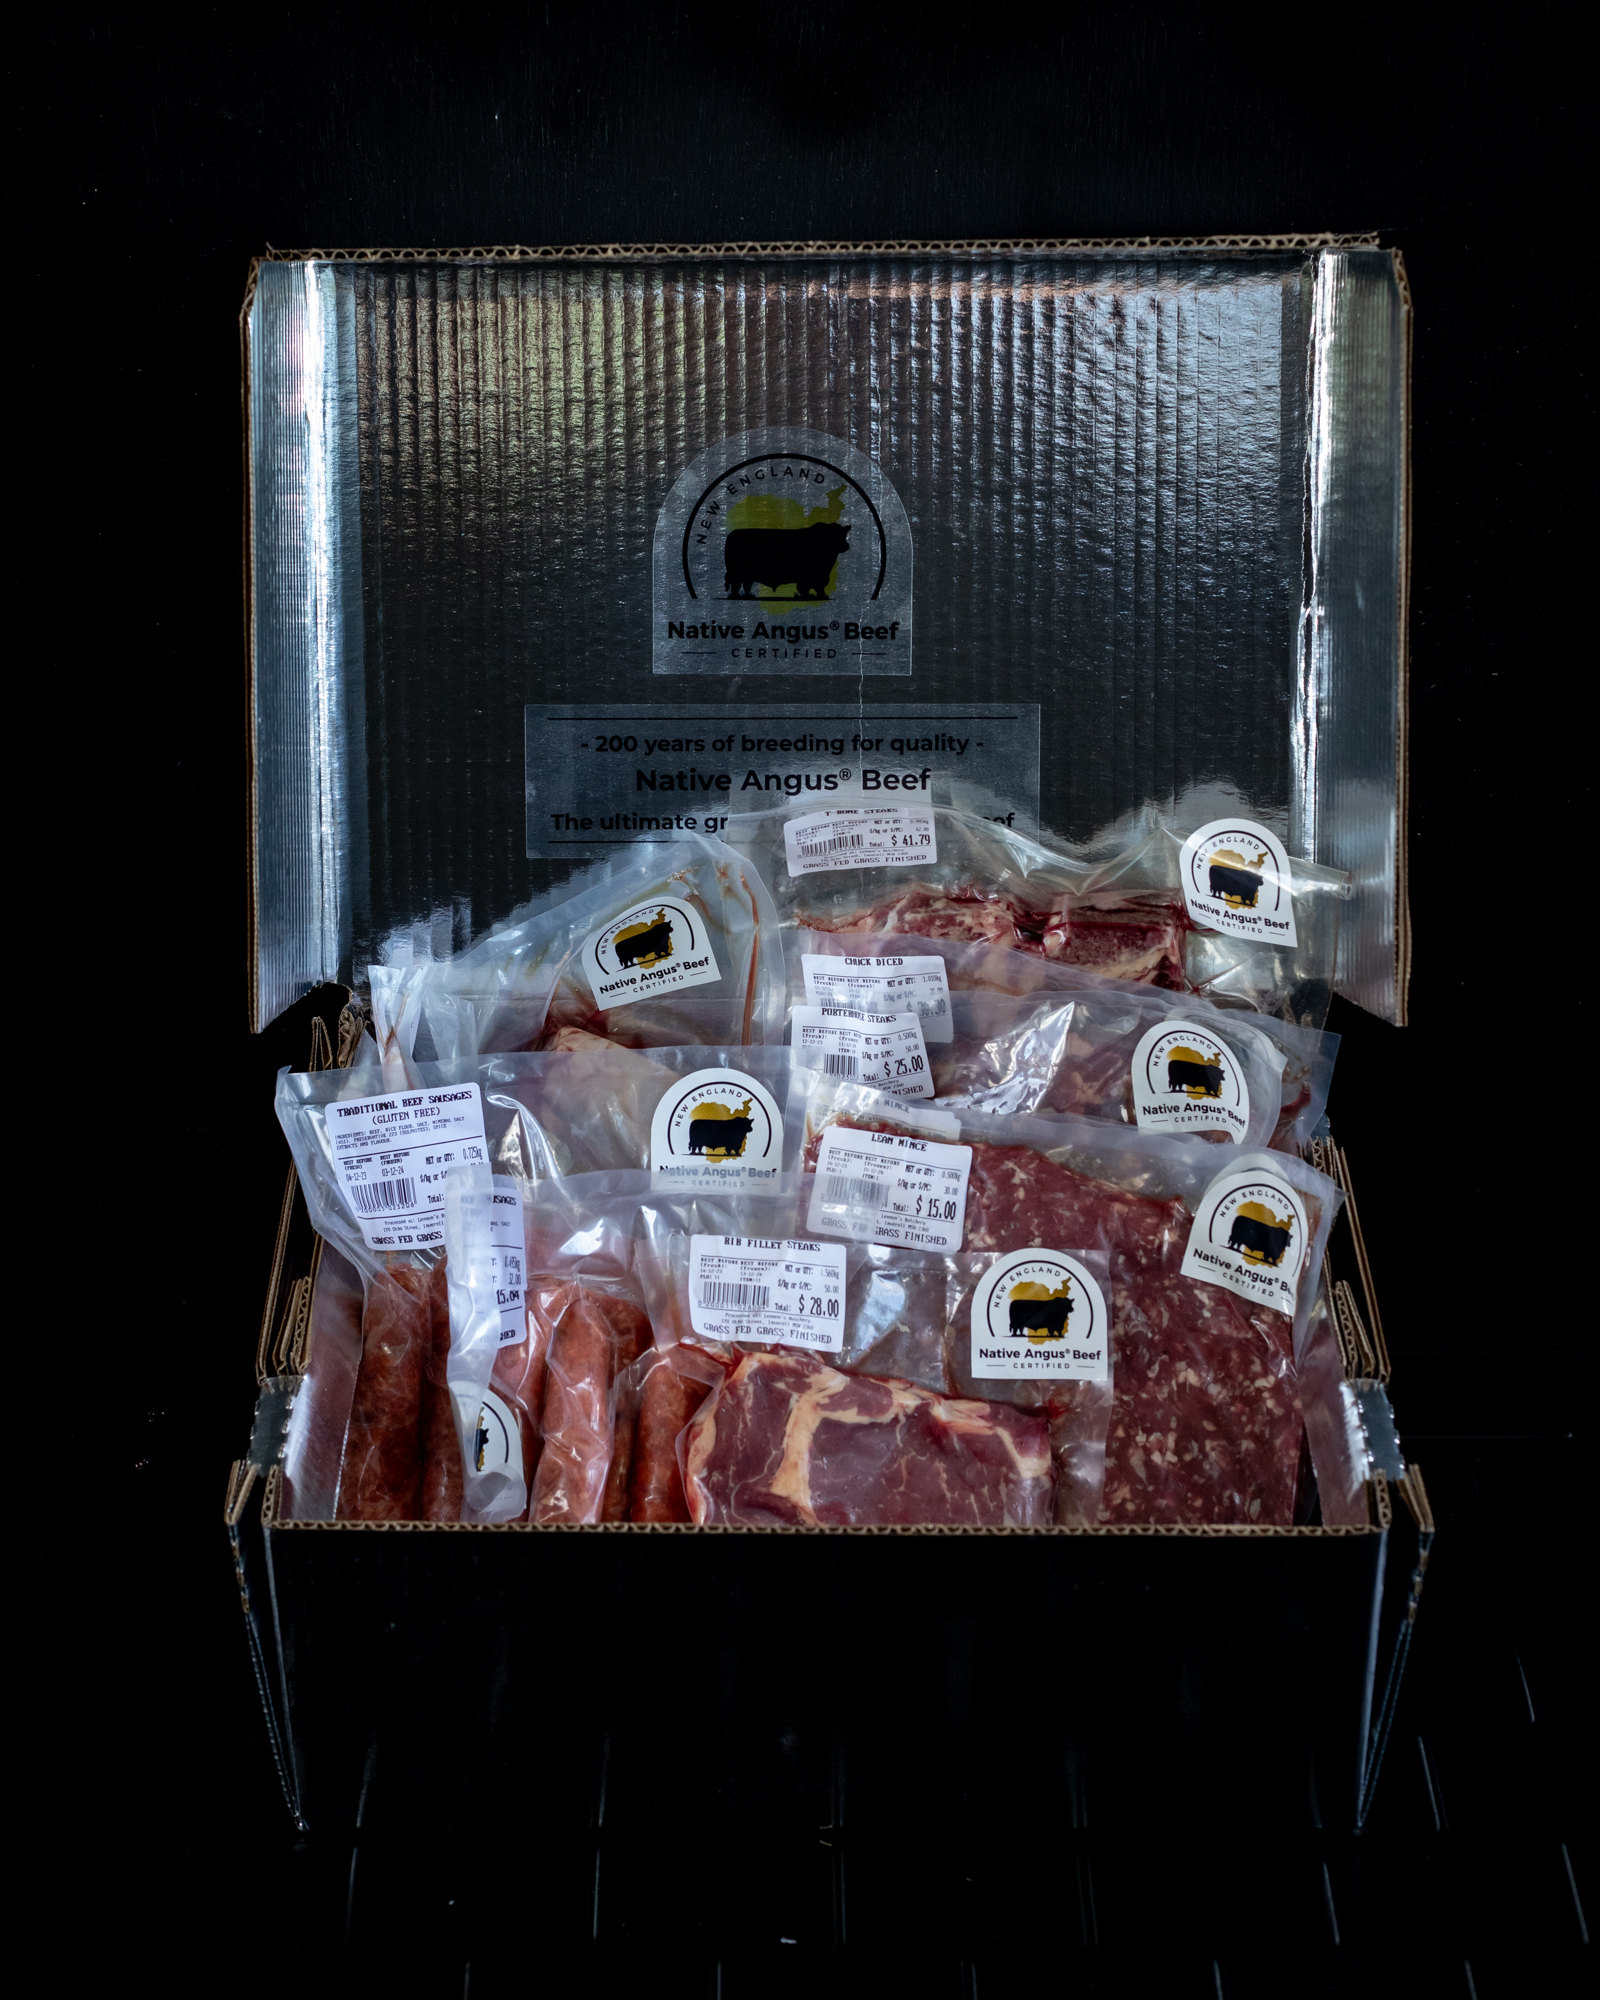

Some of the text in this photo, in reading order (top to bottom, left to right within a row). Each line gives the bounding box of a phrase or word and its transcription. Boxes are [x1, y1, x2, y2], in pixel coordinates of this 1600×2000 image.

[695, 466, 826, 545] NEW ENGLAND
[667, 620, 745, 640] Native
[844, 621, 899, 640] Beef
[731, 648, 837, 659] CERTIFIED
[595, 733, 970, 756] 200 years of breeding for quality
[636, 768, 732, 791] Native
[862, 768, 932, 790] Beef
[550, 812, 698, 830] The ultimate
[891, 834, 898, 847] $
[902, 834, 931, 846] 41.79
[854, 856, 880, 864] GRASS
[885, 854, 927, 863] FINISHED
[1190, 899, 1220, 916] Native
[1264, 918, 1290, 931] Beef
[600, 938, 609, 955] NEW
[875, 957, 904, 966] DICED
[599, 977, 637, 994] Native
[683, 957, 710, 971] Beef
[632, 974, 685, 993] CERTIFIED
[867, 1014, 897, 1024] STEAKS
[1153, 1035, 1212, 1067] NEW ENGLAND
[862, 1073, 879, 1081] Total:
[883, 1061, 891, 1077] $
[894, 1055, 924, 1076] 25.00
[336, 1090, 473, 1117] TRADITIONAL BEEF SAUSAGES
[674, 1087, 743, 1128] NEW ENGLAND
[372, 1106, 441, 1126] (GLUTEN FREE)
[1142, 1103, 1180, 1116] Native
[1227, 1109, 1246, 1128] Beef
[1174, 1115, 1227, 1124] CERTIFIED
[897, 1138, 928, 1152] MINCE
[659, 1165, 699, 1177] Native
[747, 1168, 778, 1179] Beef
[427, 1193, 445, 1204] Total:
[892, 1194, 957, 1220] Total: $ 15.00
[1219, 1189, 1289, 1218] NEW ENGLAND
[371, 1230, 443, 1245] GRASS FED GRASS
[723, 1236, 821, 1252] RIB FILLET STEAKS
[904, 1230, 947, 1246] FINISHED
[1192, 1248, 1232, 1270] Native
[994, 1266, 1061, 1308] NEW ENGLAND
[1222, 1272, 1274, 1297] CERTIFIED
[774, 1293, 839, 1318] Total: $ 28.00
[703, 1322, 832, 1344] GRASS FED GRASS FINISHED
[979, 1348, 1020, 1360] Native
[1072, 1350, 1102, 1361] Beef
